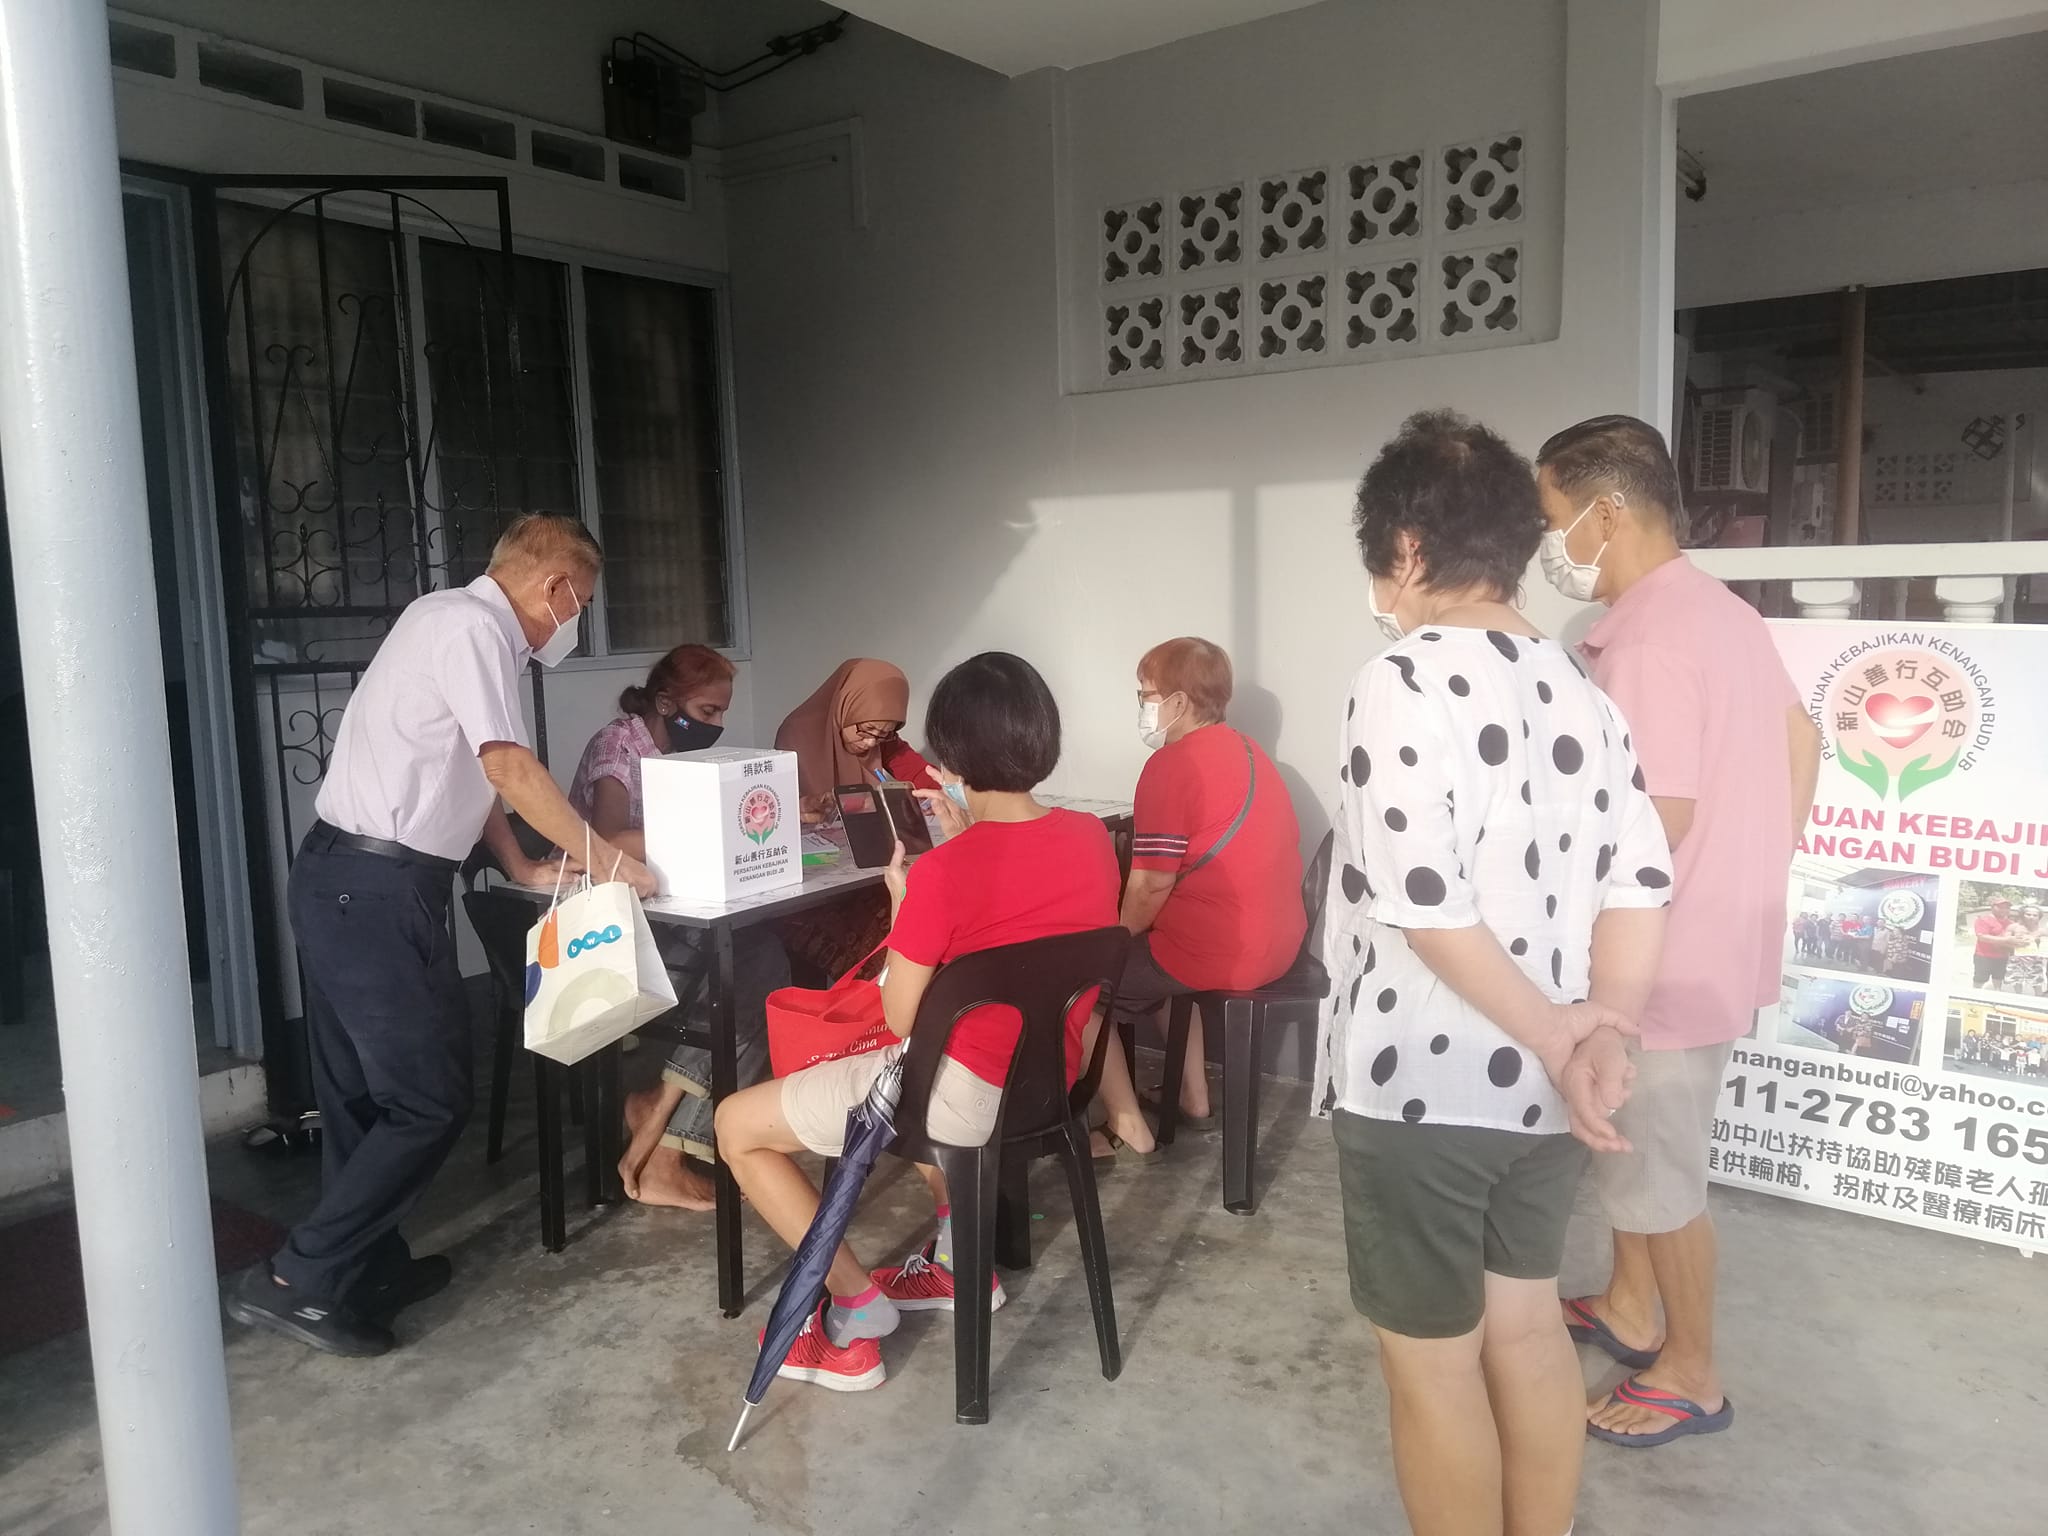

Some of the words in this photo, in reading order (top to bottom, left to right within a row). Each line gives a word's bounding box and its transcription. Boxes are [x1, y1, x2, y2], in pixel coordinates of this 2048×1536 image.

[1830, 632, 1925, 672] KEBAJIKAN
[1928, 636, 1995, 708] KENANGAN
[1836, 659, 1967, 739] 新山善行互助会
[1972, 712, 1996, 751] BUDI
[743, 760, 773, 777] 捐款箱
[1958, 751, 1977, 771] JB
[1812, 805, 1885, 831] UAN
[1796, 833, 1916, 865] ANGAN
[1929, 846, 2020, 875] BUDI
[1732, 1048, 2048, 1117] nanganbudi@yahoo.c
[1726, 1075, 1931, 1142] 11-2783
[1953, 1116, 2048, 1165] 165
